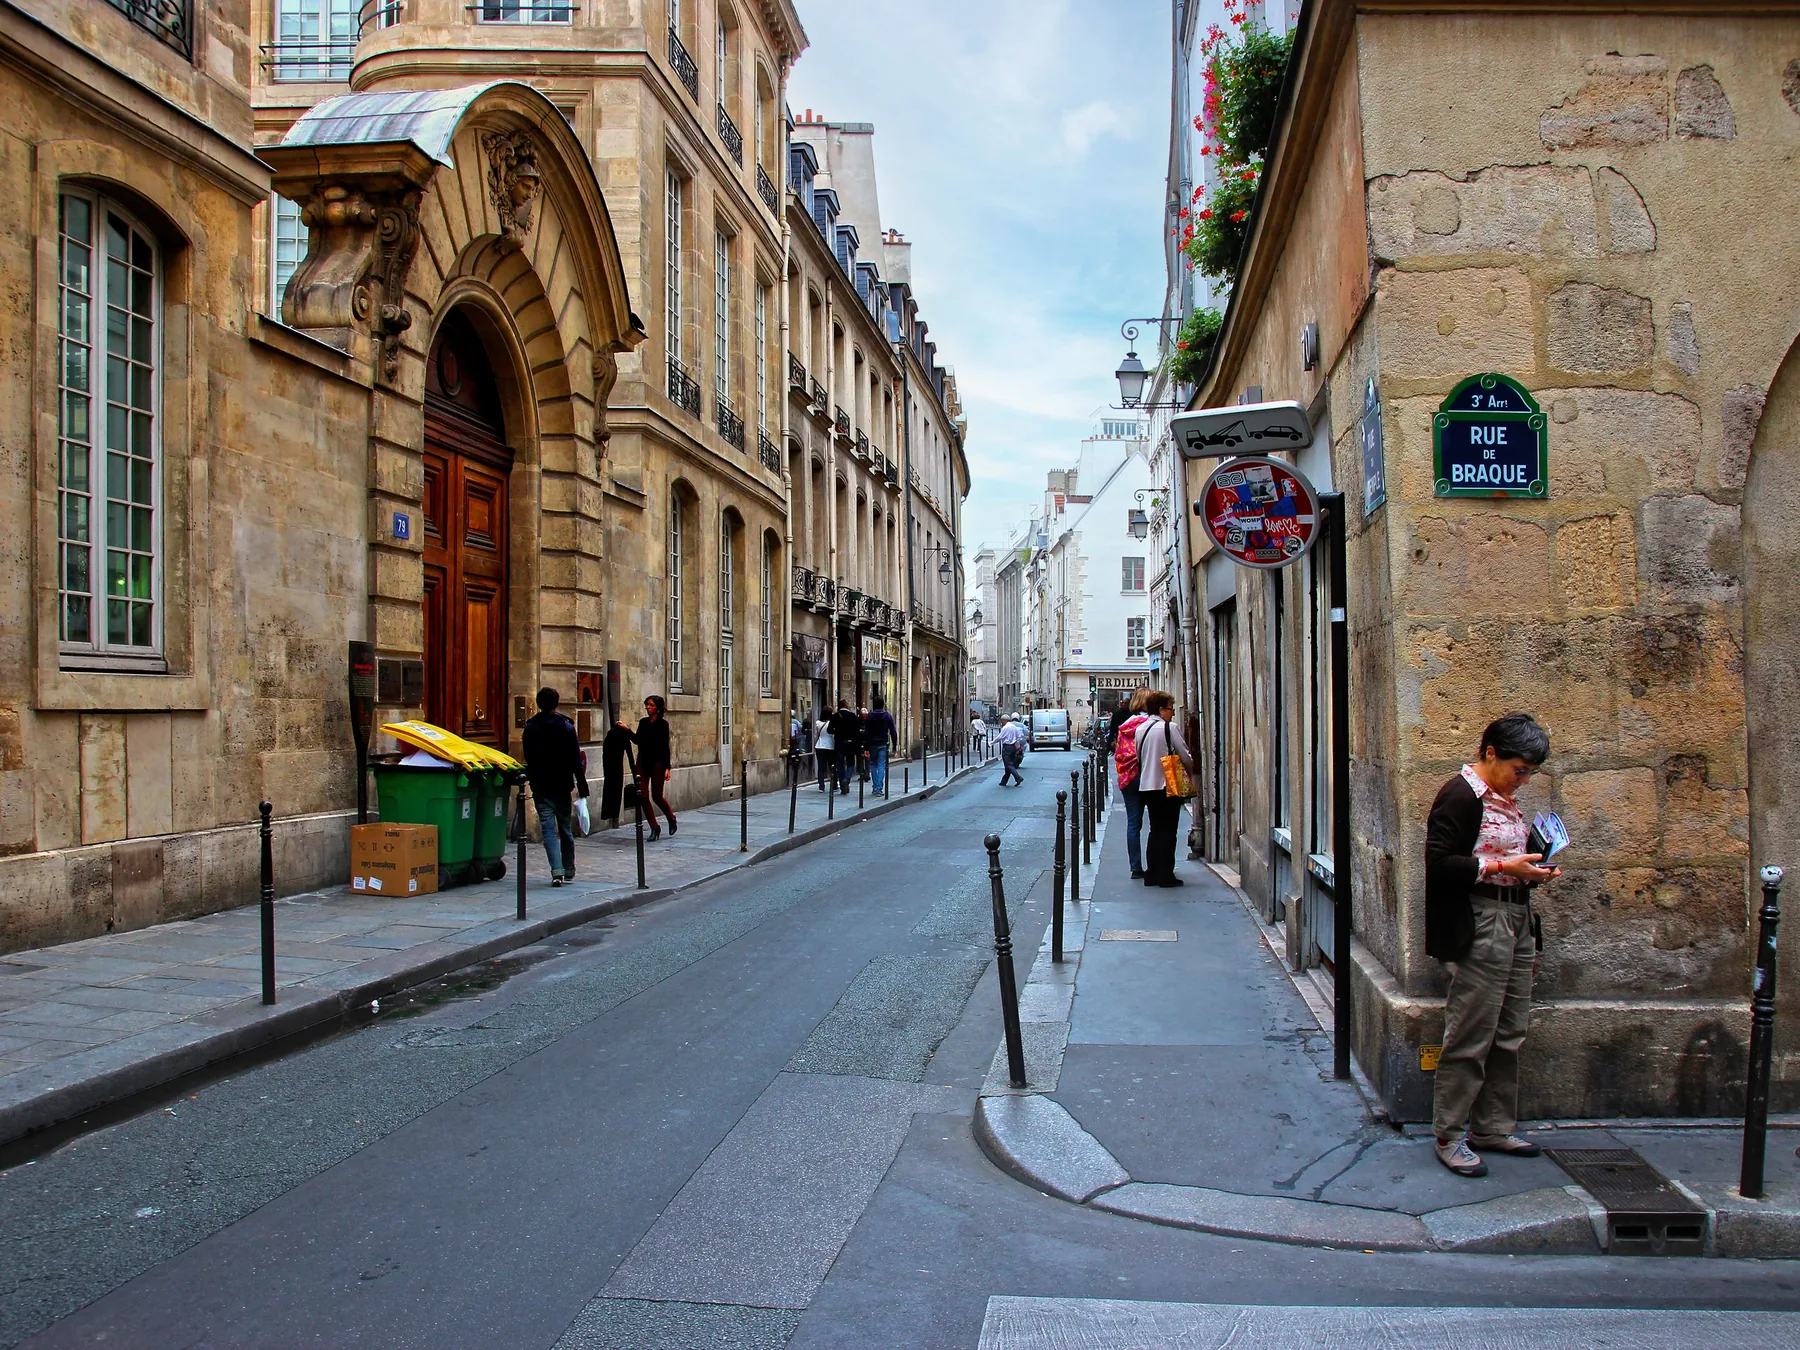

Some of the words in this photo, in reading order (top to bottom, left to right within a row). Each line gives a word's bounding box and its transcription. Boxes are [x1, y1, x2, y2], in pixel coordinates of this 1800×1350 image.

[1470, 426, 1507, 445] RUE
[1483, 449, 1496, 459] DE
[1452, 464, 1527, 484] BRAQUE
[397, 519, 406, 533] 79
